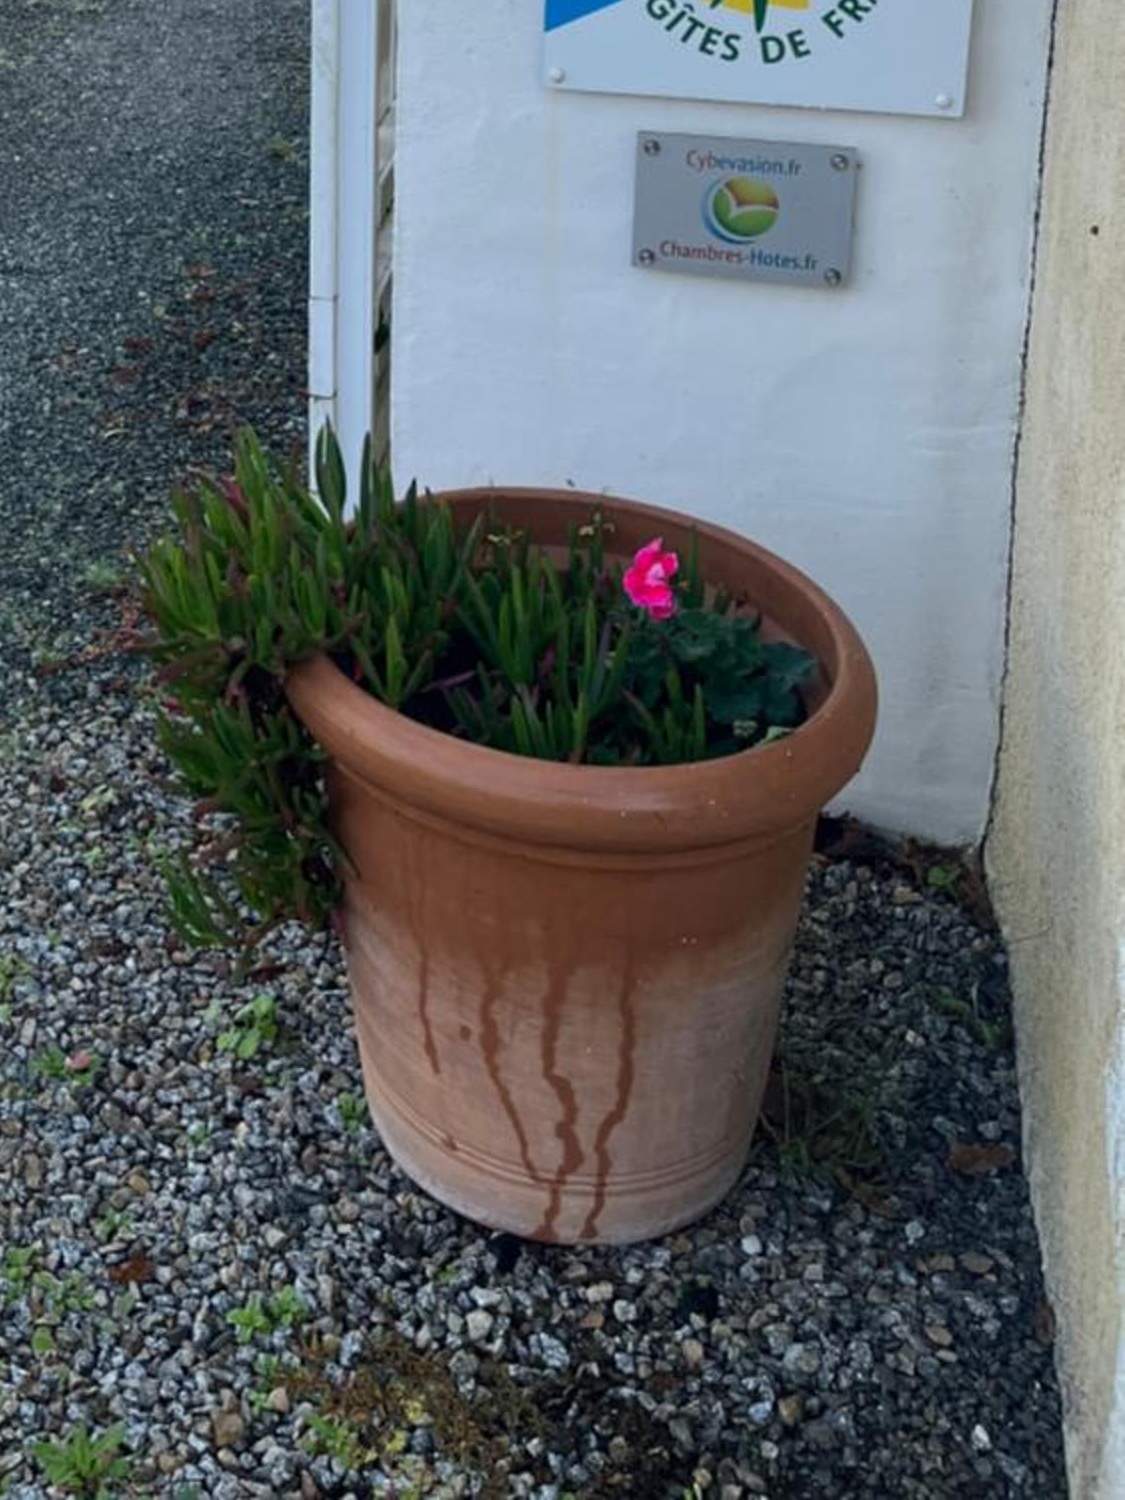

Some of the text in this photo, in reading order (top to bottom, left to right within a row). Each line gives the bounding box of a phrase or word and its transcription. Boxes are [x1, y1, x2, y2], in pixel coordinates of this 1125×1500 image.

[761, 29, 812, 65] DE
[686, 149, 802, 177] Cybevasion.fr
[659, 239, 819, 272] Chambres-Hotes.fr
